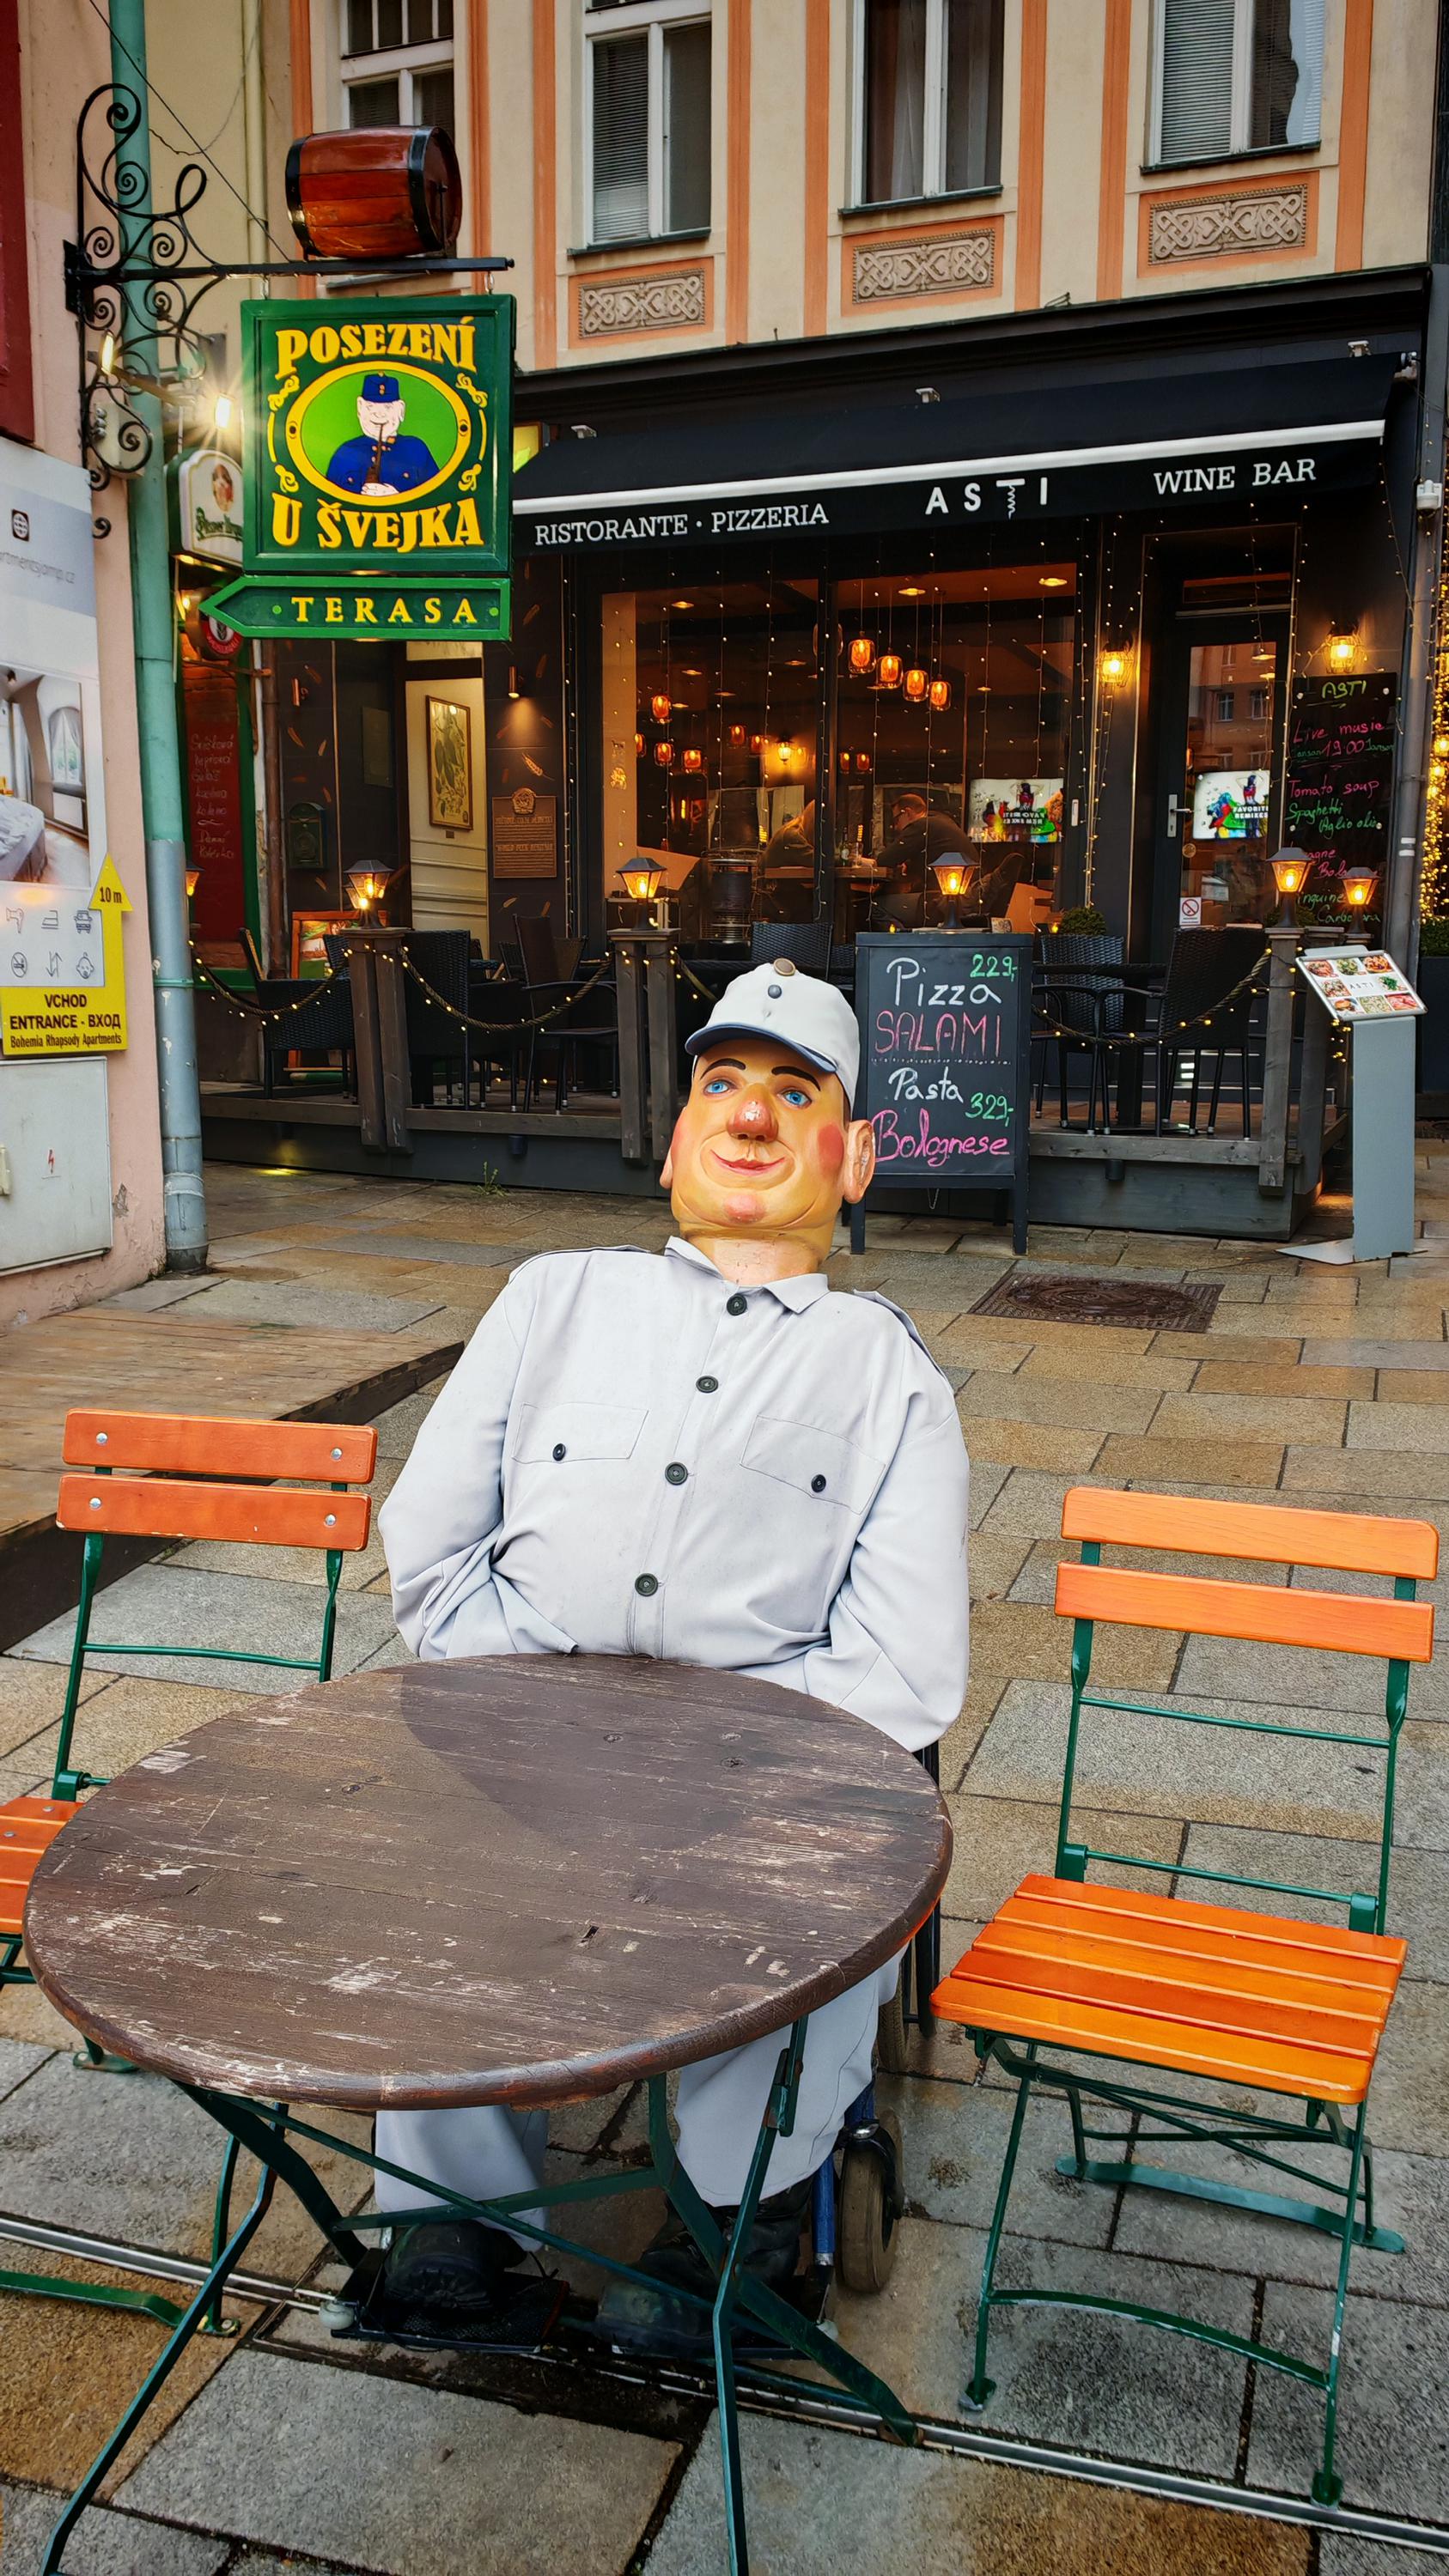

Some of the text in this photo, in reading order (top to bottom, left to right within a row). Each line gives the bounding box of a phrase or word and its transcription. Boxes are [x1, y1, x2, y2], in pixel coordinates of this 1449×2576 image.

[275, 316, 477, 380] POSEZENÍ
[1153, 459, 1317, 495] WINE BAR
[925, 477, 1049, 519] ASTI
[271, 492, 484, 553] U ŠVEJKA
[534, 503, 830, 545] RISTORANTE PIZZERIA
[291, 597, 478, 623] TERASA
[1322, 680, 1367, 699] ASTI
[1293, 720, 1329, 744] Live
[1288, 775, 1379, 799] Tomato soup
[1285, 799, 1343, 825] Spaghetti
[1318, 816, 1353, 839] Aglio
[100, 887, 123, 903] 10 m
[1298, 891, 1345, 910] inguine
[886, 957, 1002, 1006] Pizza
[44, 993, 88, 1008] VCHOD
[9, 1014, 78, 1030] ENTRANCE
[88, 1013, 121, 1029] ВХОД
[875, 1010, 1001, 1058] SALAMI
[10, 1032, 122, 1048] Bohemia Rhapsody Apartments
[888, 1066, 964, 1103] Pasta
[872, 1108, 1010, 1167] Bolognese
